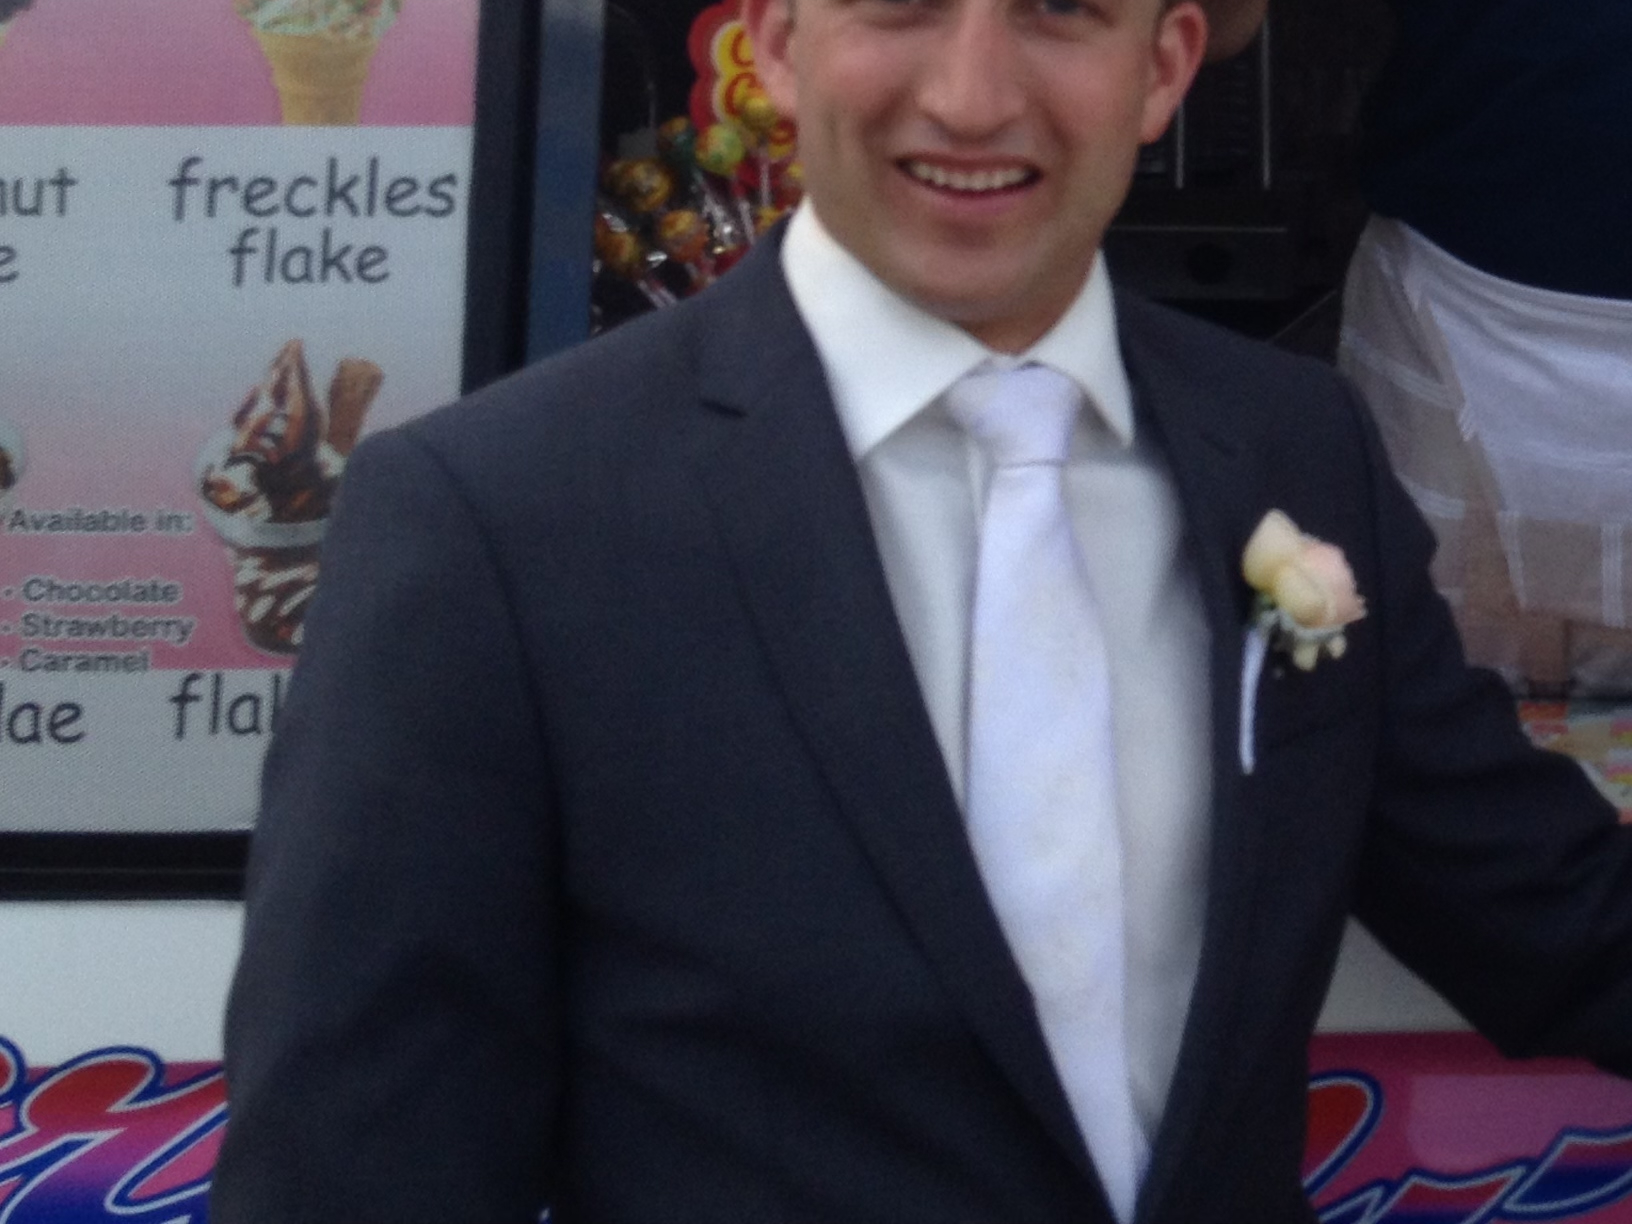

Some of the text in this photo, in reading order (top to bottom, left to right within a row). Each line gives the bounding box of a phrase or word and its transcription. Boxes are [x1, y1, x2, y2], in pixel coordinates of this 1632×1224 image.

[0, 168, 78, 217] ut
[168, 155, 458, 222] freckles
[228, 226, 391, 288] flake
[9, 509, 147, 533] Available
[22, 577, 179, 603] Chocolate
[20, 612, 193, 644] Strawberry
[20, 648, 149, 673] Caramel
[0, 672, 284, 744] ae fla
